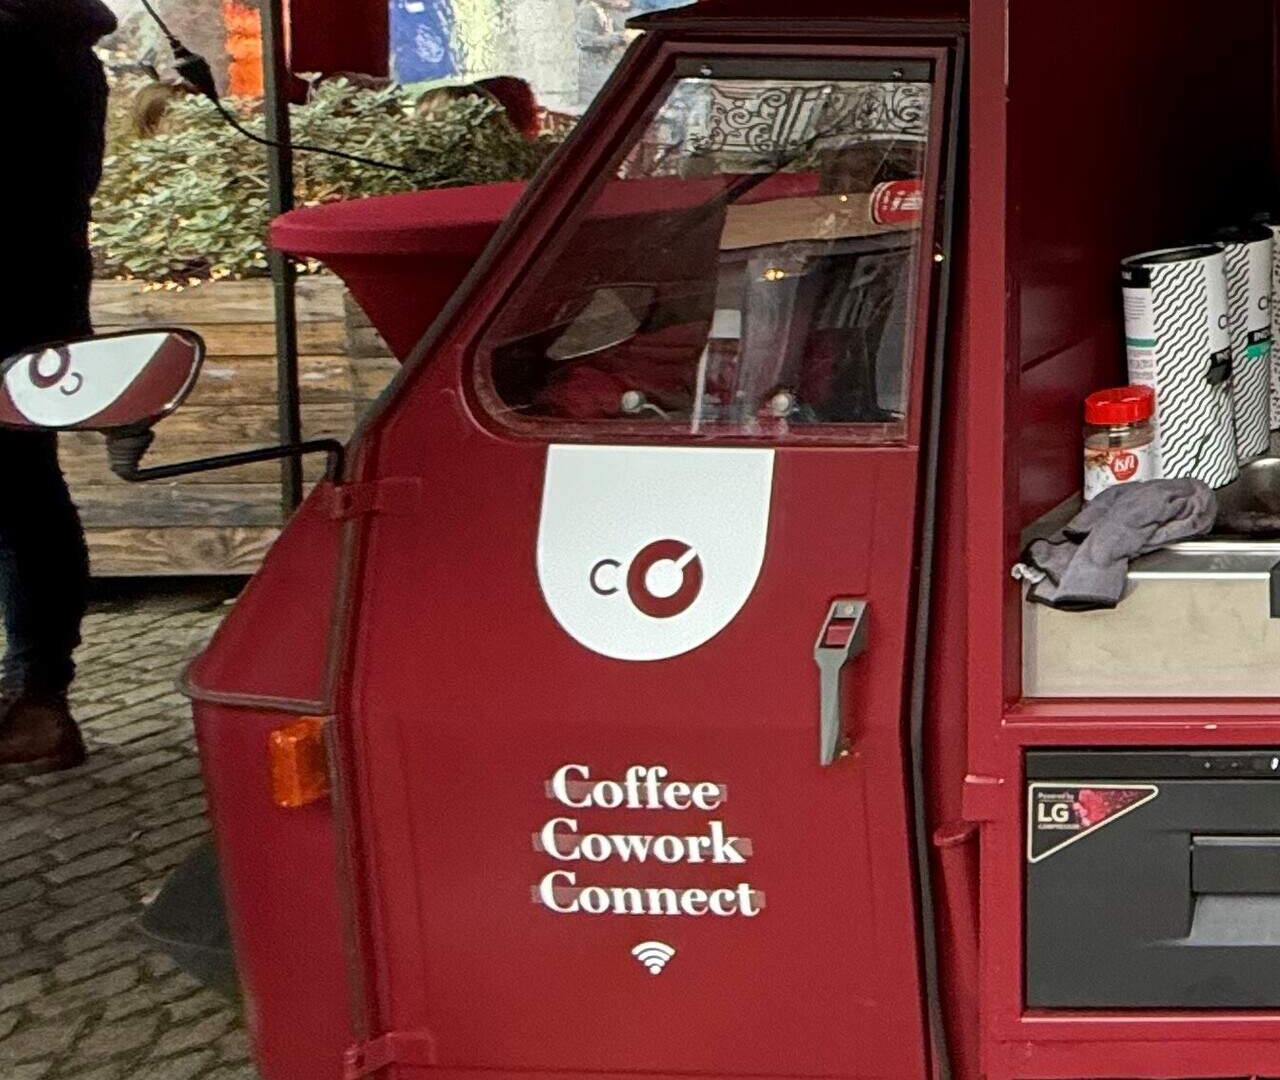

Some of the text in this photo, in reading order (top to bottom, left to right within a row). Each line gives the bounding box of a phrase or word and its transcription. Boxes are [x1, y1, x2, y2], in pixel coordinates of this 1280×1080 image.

[552, 764, 722, 810] Coffee
[1038, 803, 1069, 823] LG
[541, 817, 746, 864] Cowork
[539, 870, 759, 917] Connect
